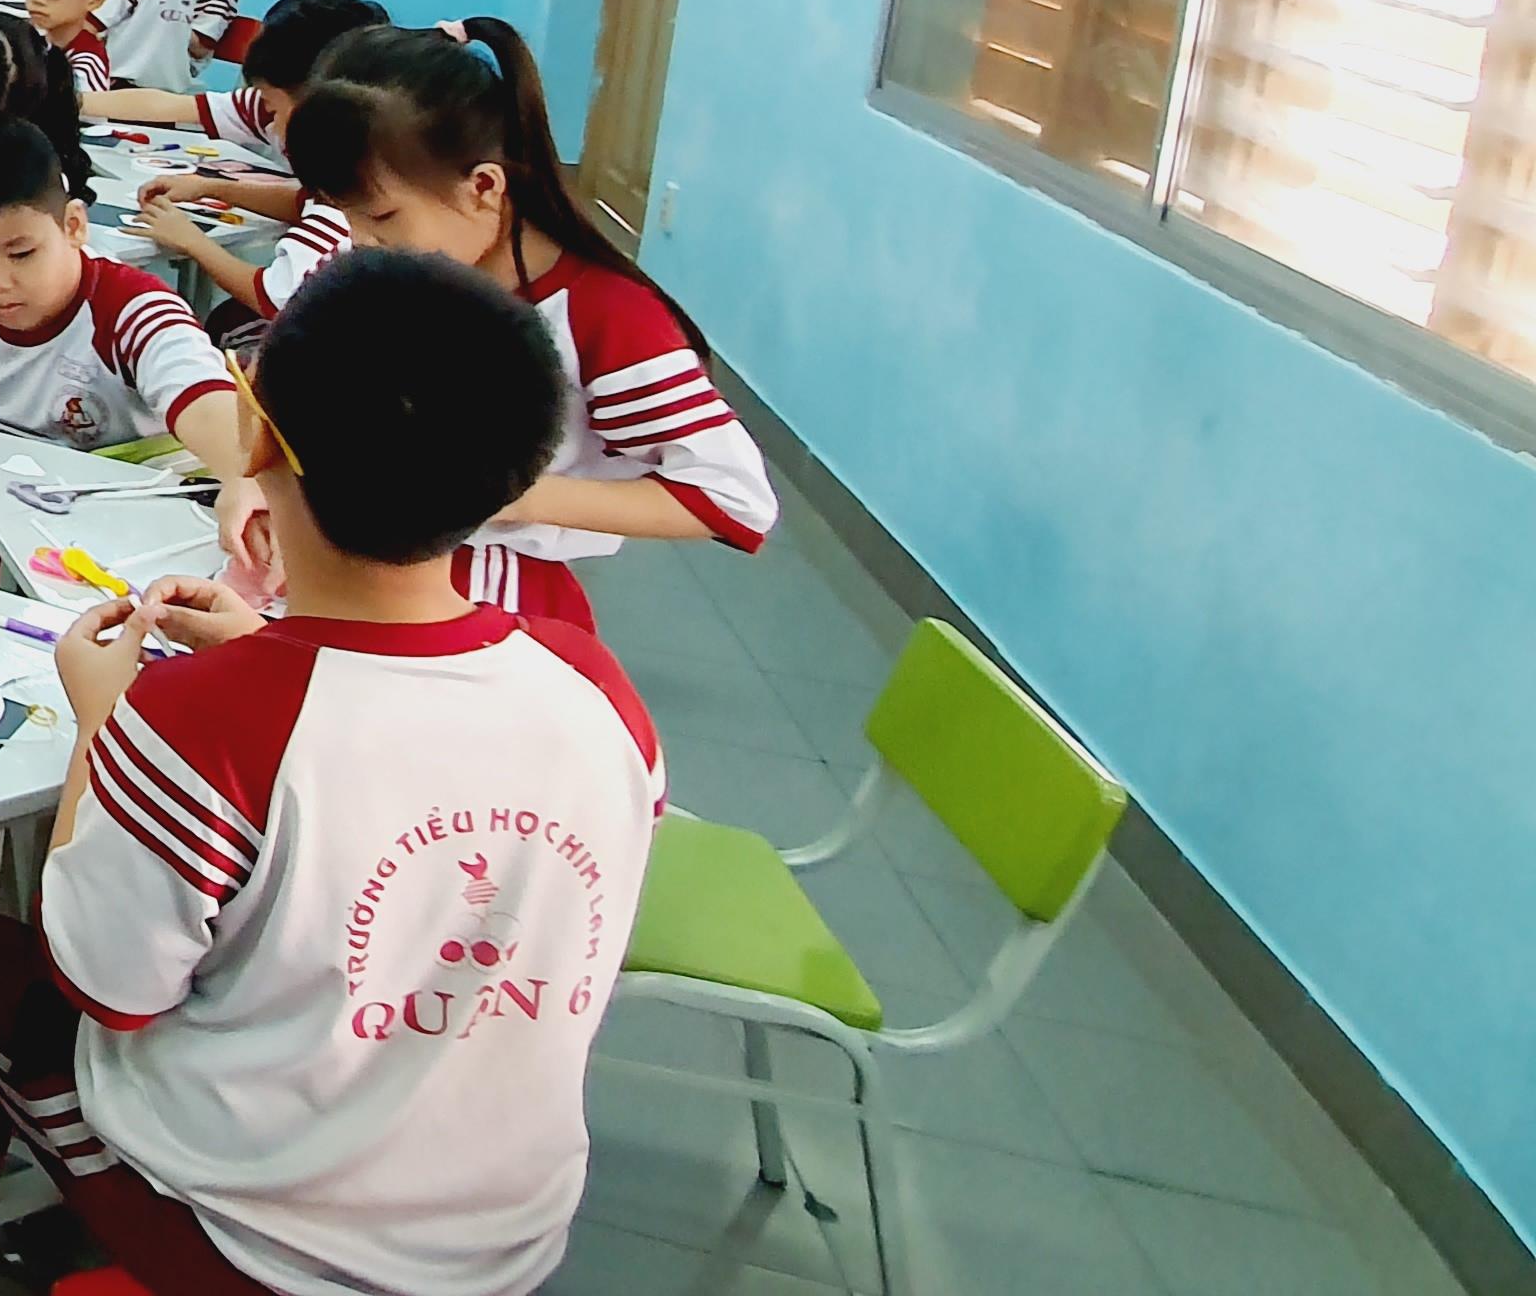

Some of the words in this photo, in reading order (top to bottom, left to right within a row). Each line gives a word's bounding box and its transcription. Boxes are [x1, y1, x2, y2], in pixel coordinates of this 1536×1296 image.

[490, 807, 561, 845] HỌC
[556, 833, 602, 890] HIM
[568, 975, 592, 1015] 6
